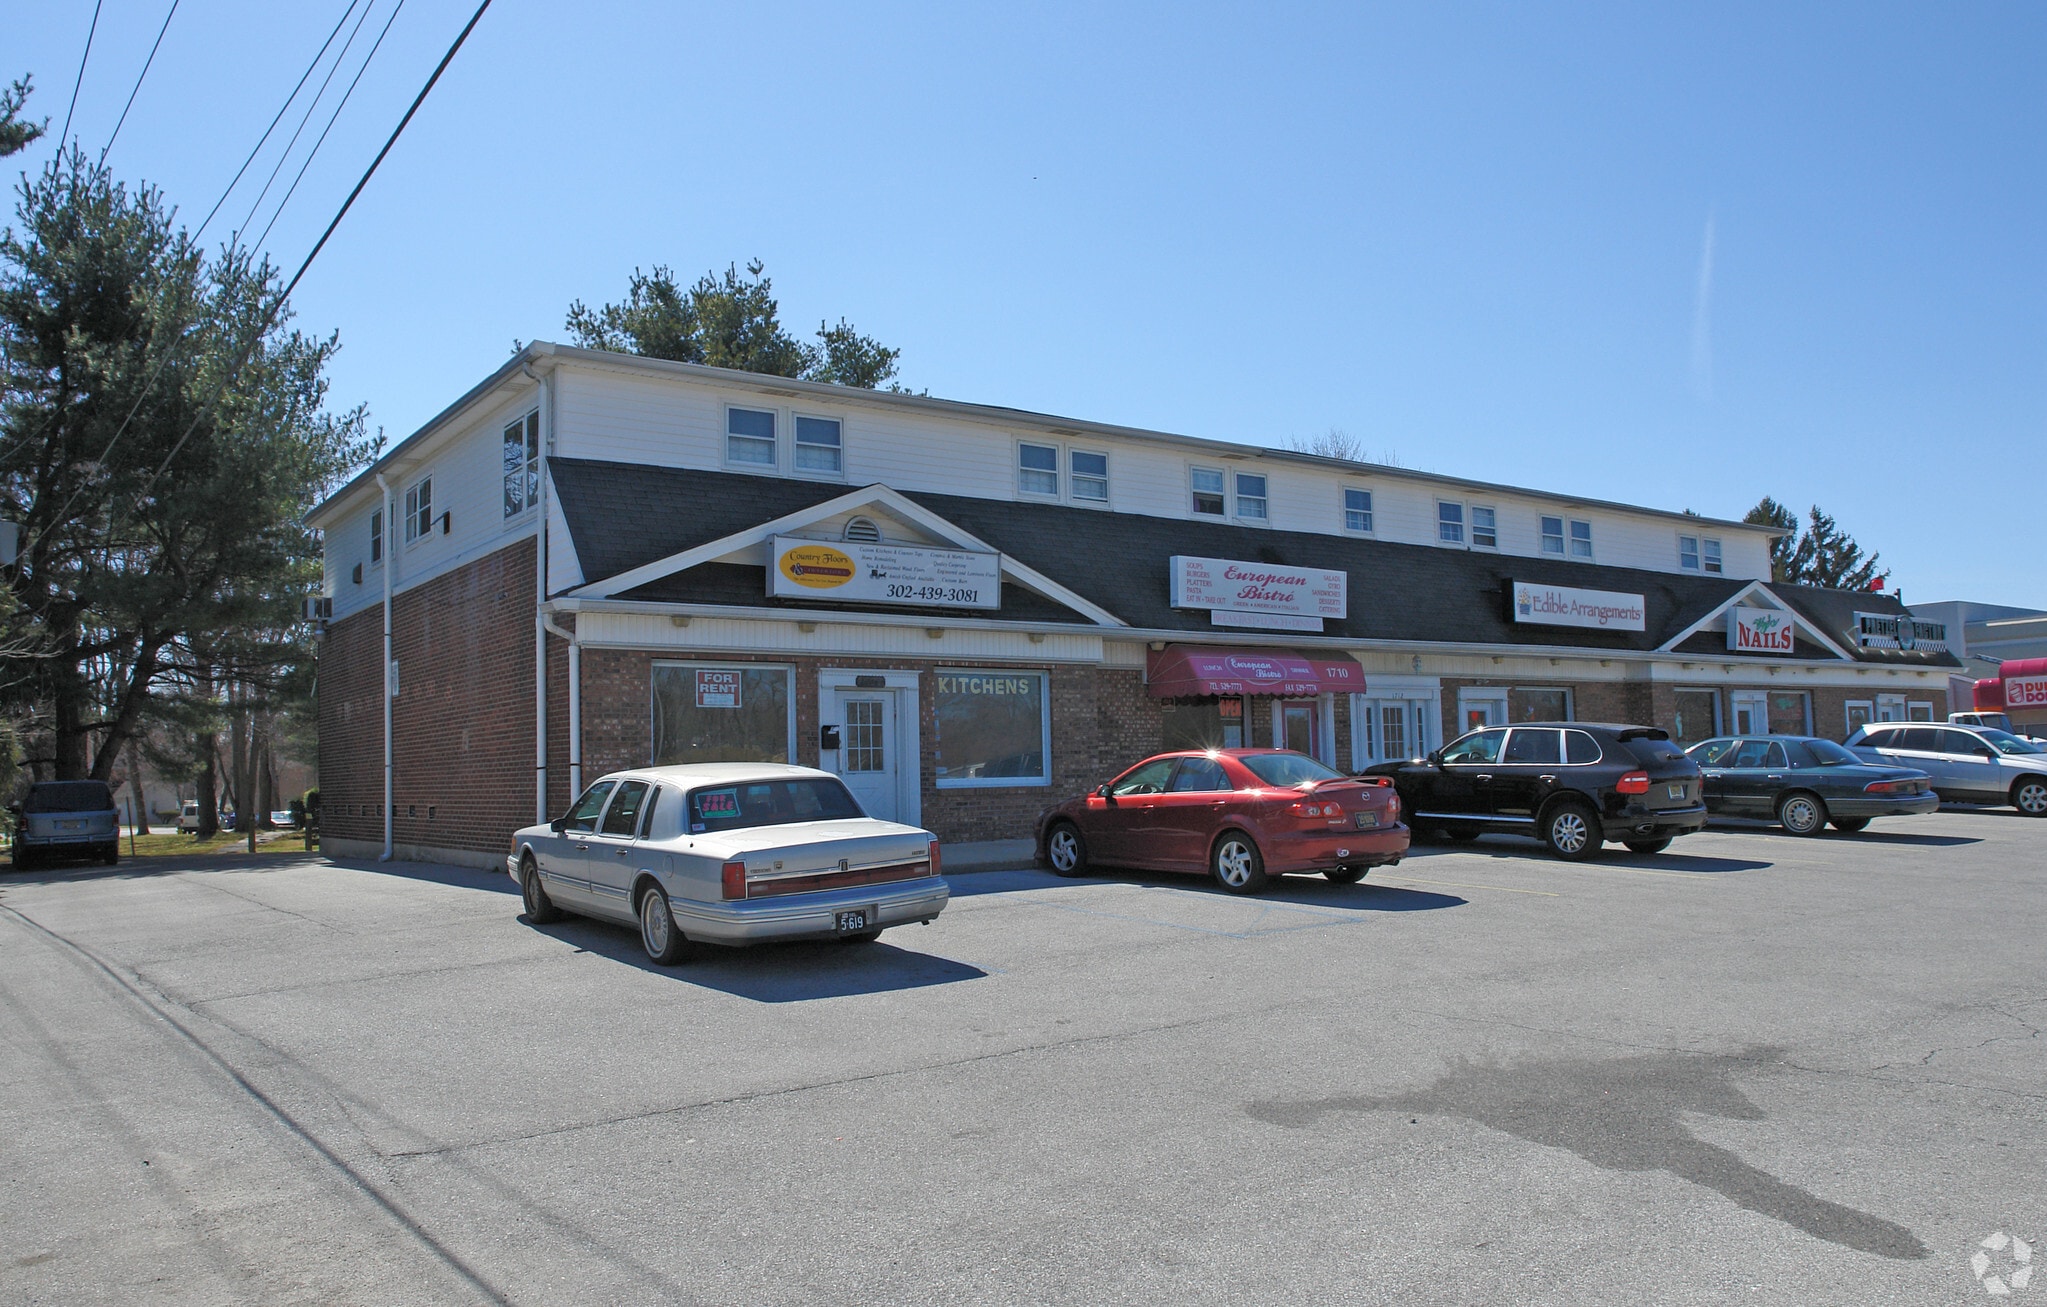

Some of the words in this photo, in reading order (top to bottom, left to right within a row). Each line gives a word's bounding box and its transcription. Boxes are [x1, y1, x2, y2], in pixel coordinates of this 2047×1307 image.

[789, 551, 820, 564] Country
[822, 553, 848, 564] Floors
[1186, 562, 1203, 570] SOUPS
[1186, 570, 1210, 578] BURGERS
[1224, 566, 1307, 588] European
[1186, 578, 1212, 587] PLATTERS
[886, 584, 978, 602] 302-439-3081
[1186, 586, 1202, 594] PASTA
[1532, 592, 1568, 615] Edible
[1569, 599, 1641, 625] Arrangements
[1738, 621, 1791, 649] NAILS
[1231, 658, 1272, 670] European
[1326, 667, 1349, 678] 1710
[704, 673, 733, 683] FOR
[699, 683, 738, 693] RENT
[938, 677, 1029, 695] KITCHENS
[1220, 699, 1242, 717] OPEN
[705, 794, 726, 802] FOR
[702, 800, 734, 812] SALE
